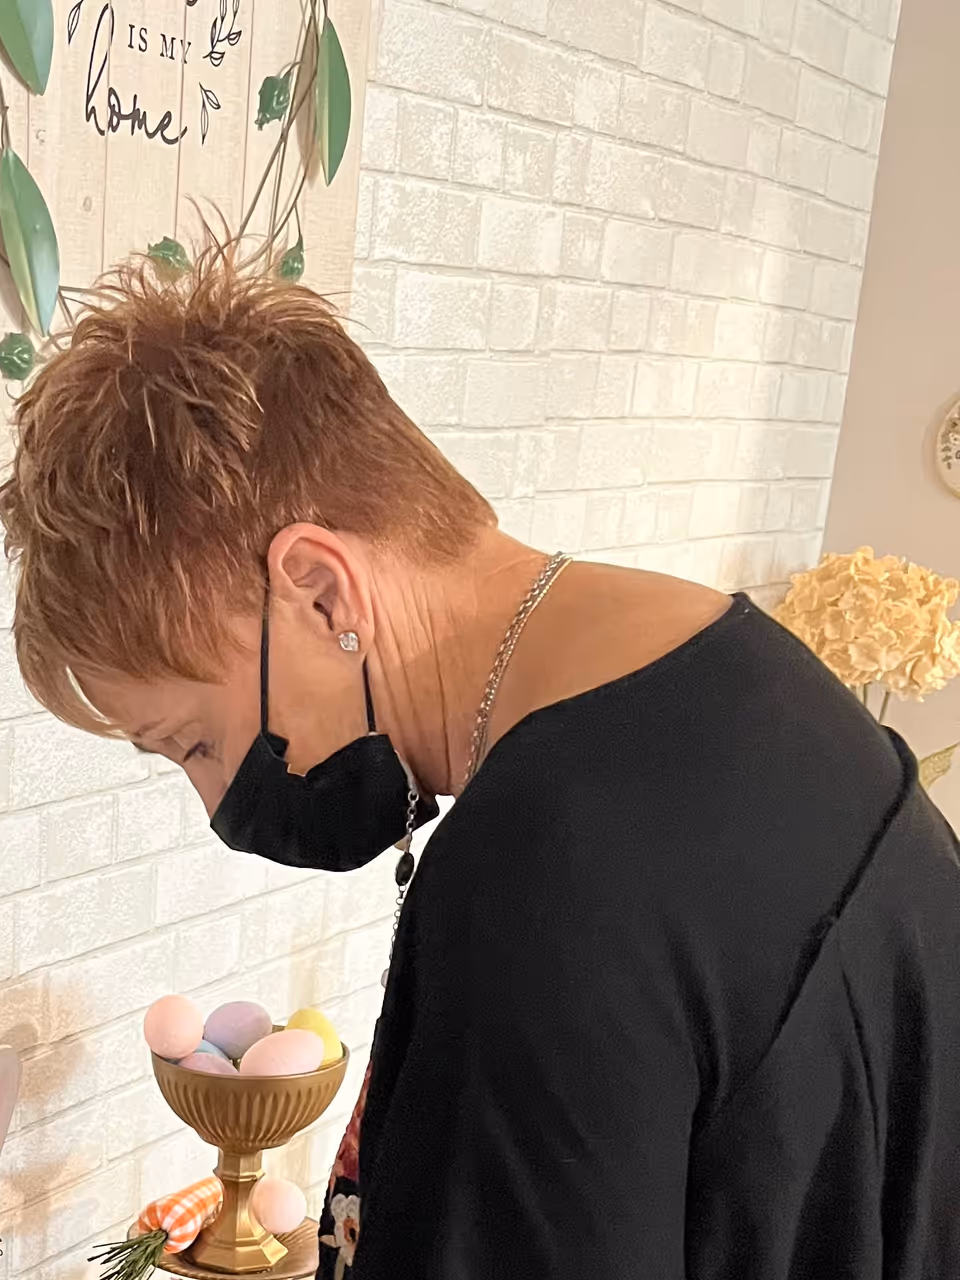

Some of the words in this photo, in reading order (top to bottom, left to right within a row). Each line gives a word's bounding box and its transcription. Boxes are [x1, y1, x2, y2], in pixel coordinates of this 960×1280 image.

[85, 3, 188, 145] home
[127, 23, 148, 52] IS
[159, 33, 191, 64] MY
